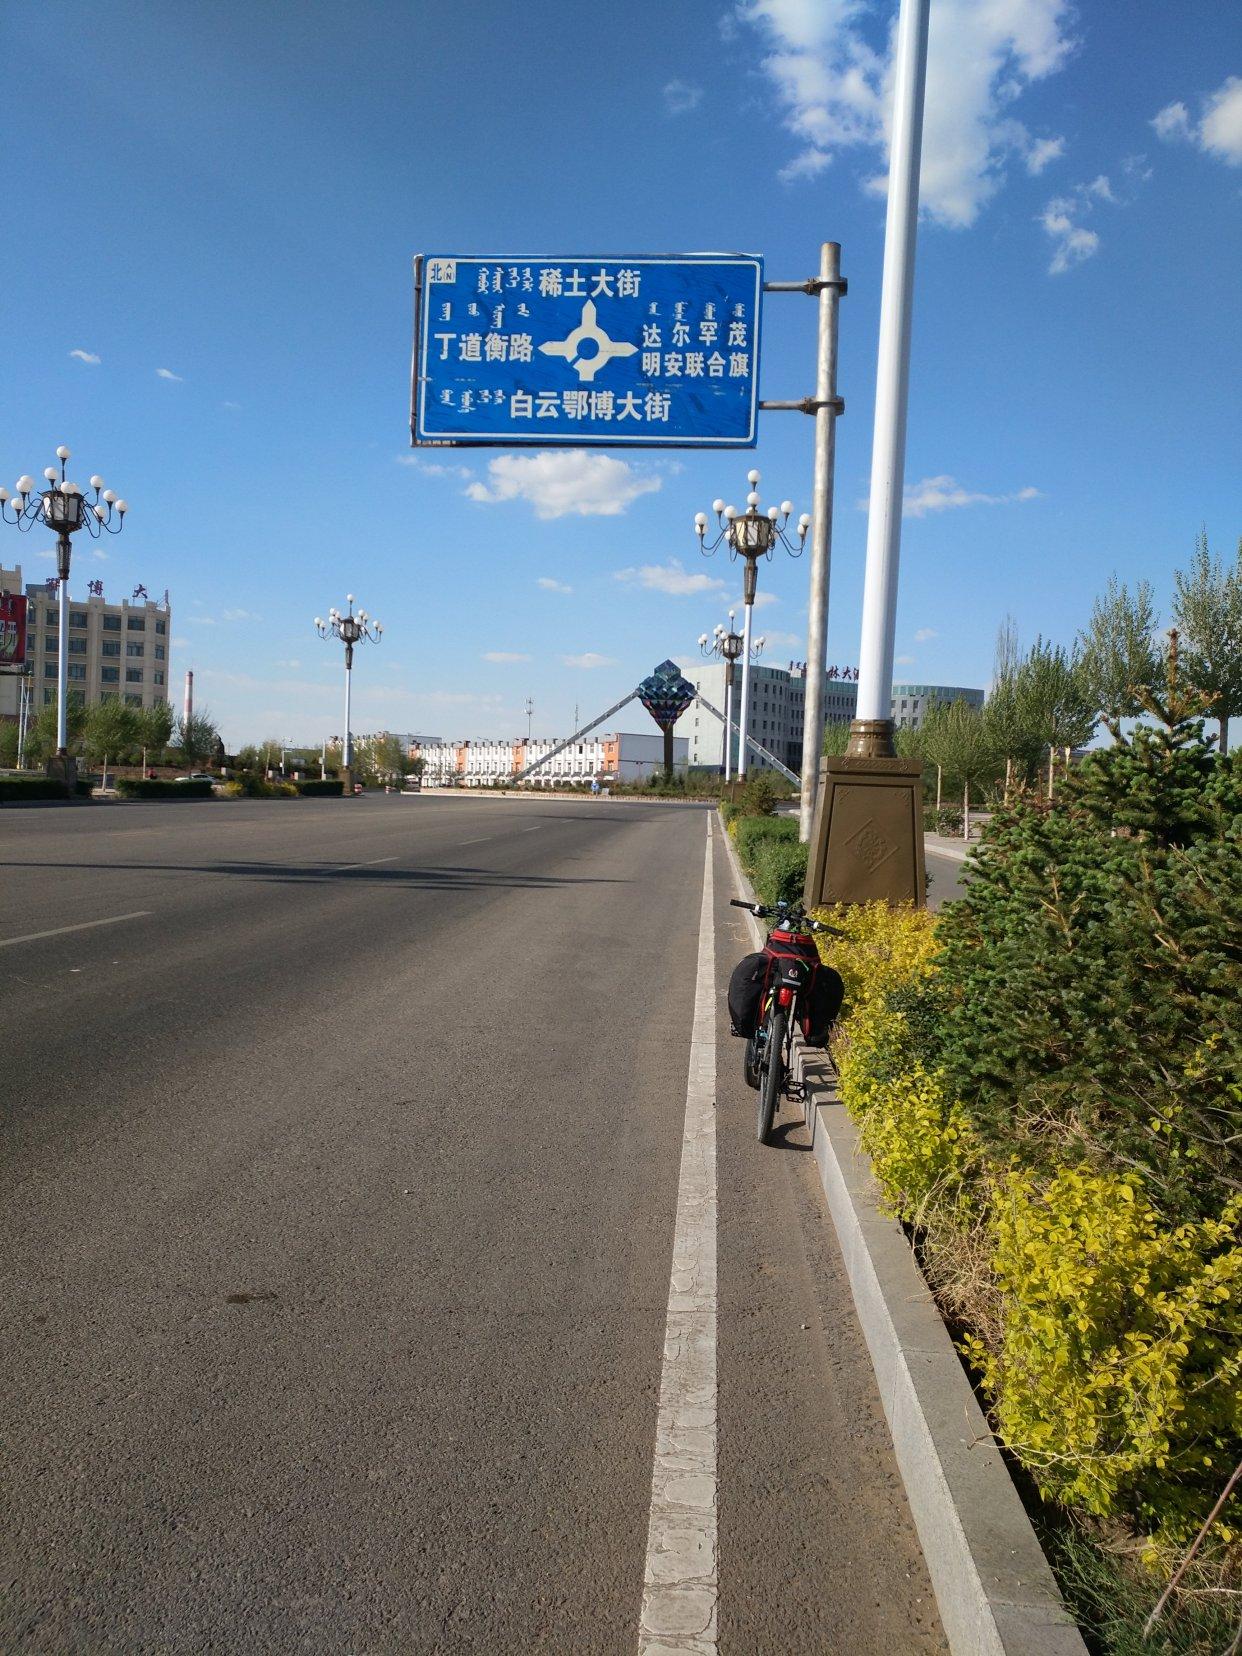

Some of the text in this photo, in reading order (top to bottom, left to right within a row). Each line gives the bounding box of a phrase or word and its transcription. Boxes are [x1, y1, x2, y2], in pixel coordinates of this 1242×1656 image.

[430, 263, 442, 281] 北
[539, 268, 641, 298] 稀土大街
[434, 332, 533, 362] 丁道衡路
[642, 321, 747, 348] 达尔罕茂
[642, 351, 749, 378] 明安联合旗
[510, 390, 671, 422] 白云鄂博大街
